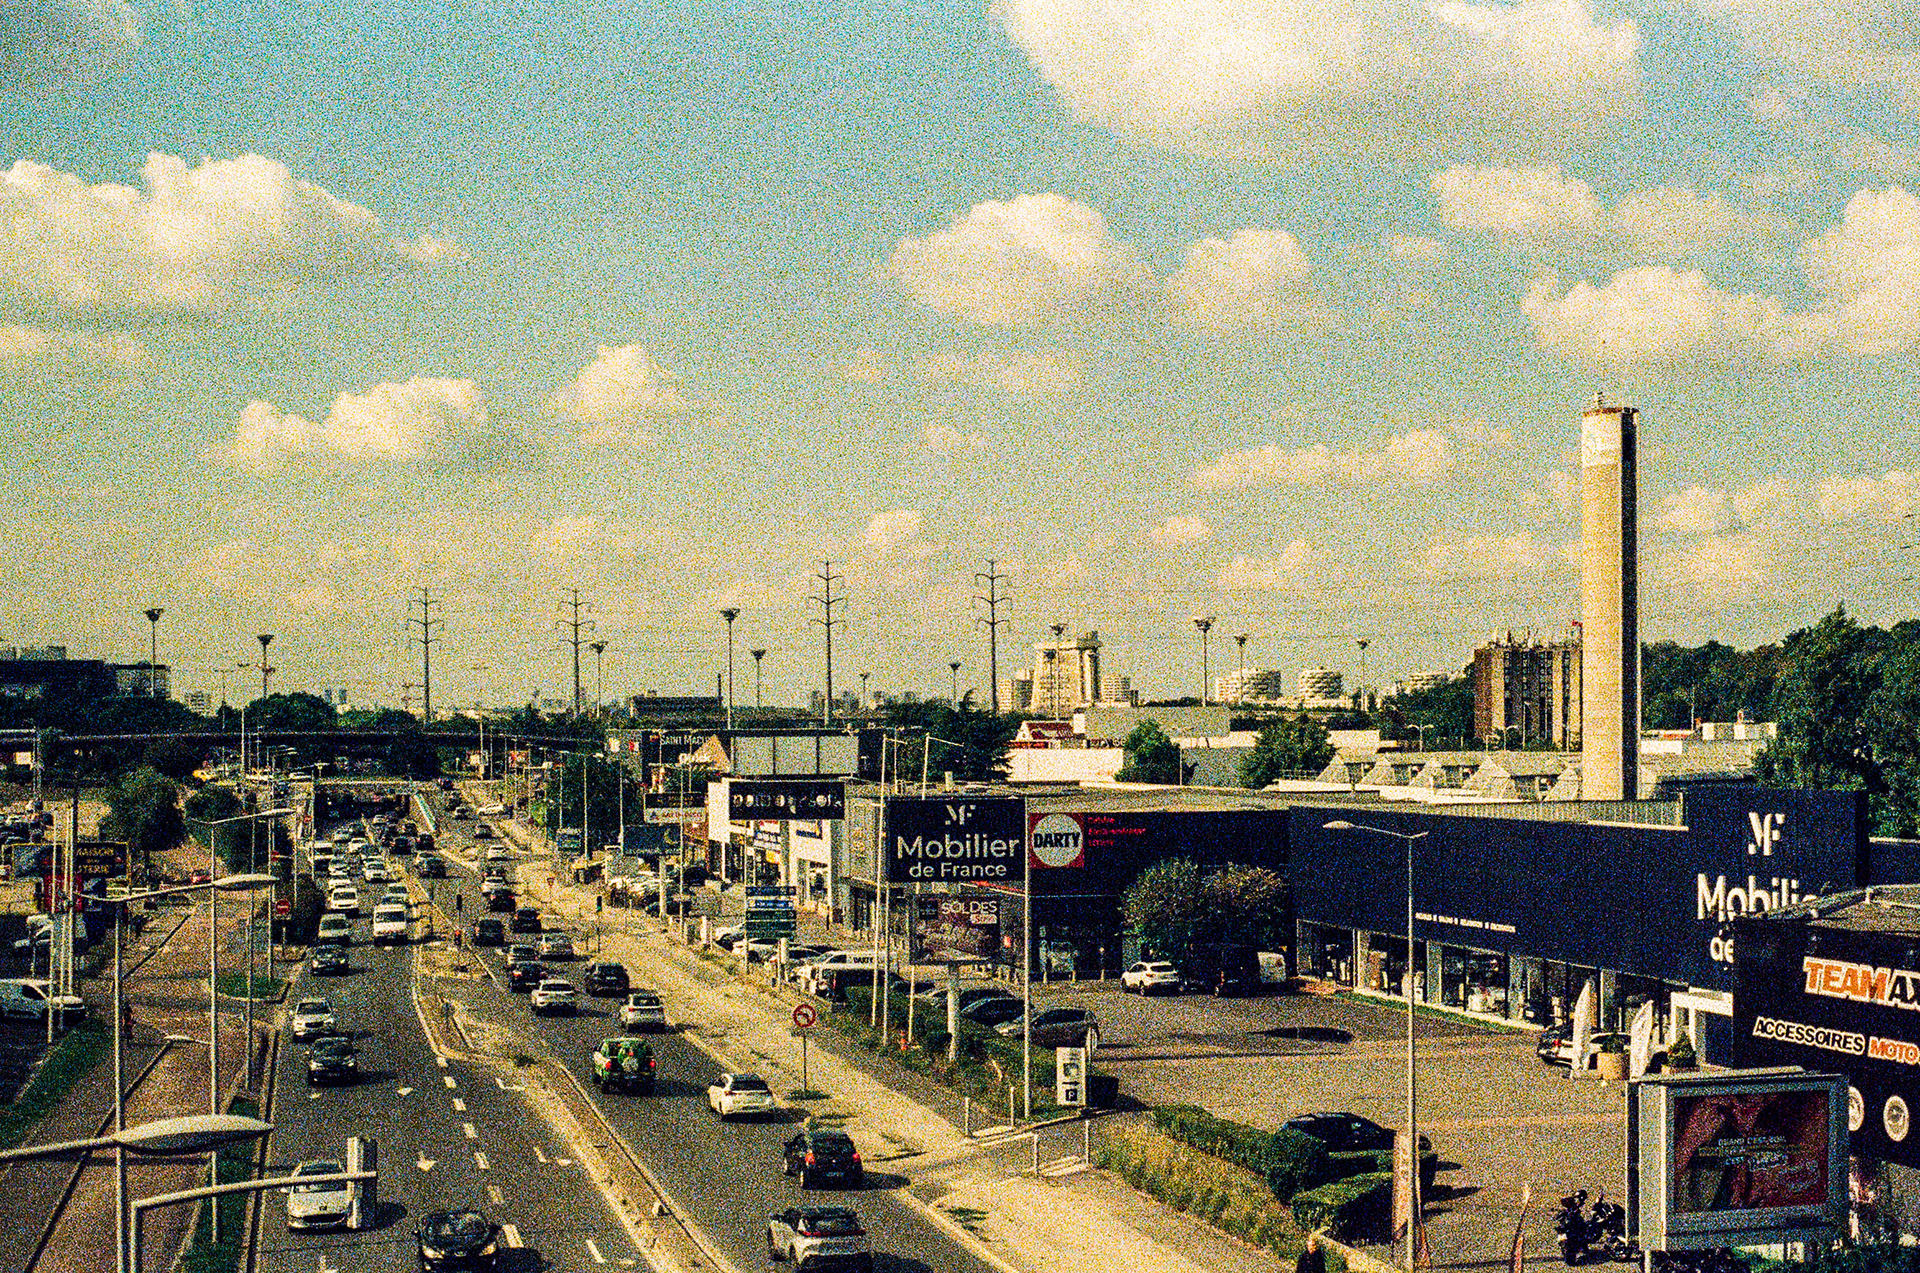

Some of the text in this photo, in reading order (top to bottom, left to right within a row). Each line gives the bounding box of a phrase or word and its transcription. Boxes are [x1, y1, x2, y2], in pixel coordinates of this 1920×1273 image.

[897, 834, 1020, 859] Mobilier
[1034, 832, 1080, 848] DARTY
[909, 862, 1007, 878] de France
[941, 900, 998, 914] SOLDES
[1753, 1017, 1865, 1055] ACCESSOIRES
